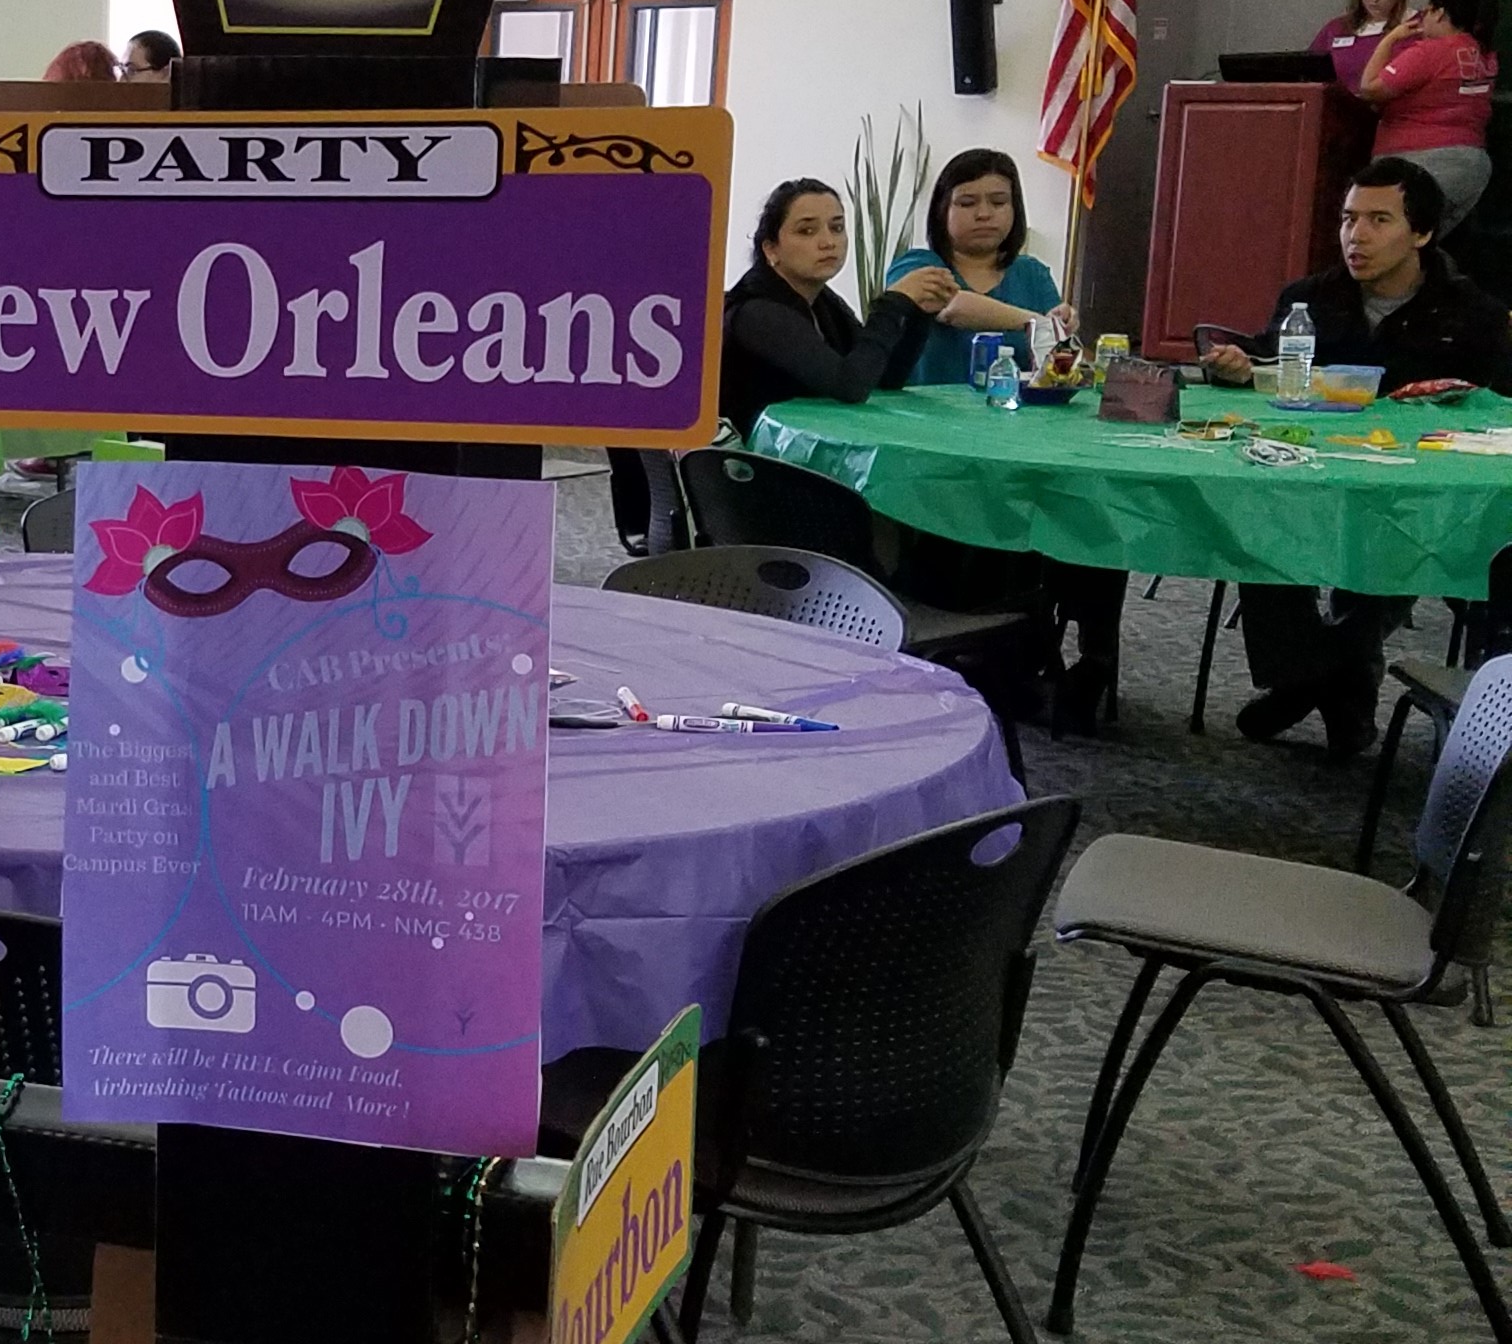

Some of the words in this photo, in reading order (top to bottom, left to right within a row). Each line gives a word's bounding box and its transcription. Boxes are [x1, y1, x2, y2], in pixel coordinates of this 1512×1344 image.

[80, 134, 453, 184] PARTY
[176, 240, 685, 389] Orleans
[267, 654, 344, 692] CAB
[73, 741, 115, 759] The
[119, 741, 194, 763] Biggest
[205, 721, 237, 790] A
[252, 702, 382, 783] WALK
[398, 682, 539, 767] DOWN
[89, 769, 128, 787] and
[135, 769, 181, 788] Best
[75, 797, 137, 815] Mardi
[143, 798, 193, 817] Gras
[320, 773, 413, 864] IVY
[89, 826, 148, 848] Party
[153, 830, 179, 845] on
[63, 853, 146, 875] Campus
[152, 855, 201, 874] Ever
[242, 866, 369, 905] February
[457, 889, 521, 915] 2017
[242, 903, 298, 924] 11AM
[321, 910, 372, 931] 4PM
[394, 915, 451, 938] NMC
[457, 922, 502, 943] 438
[89, 1044, 147, 1067] There
[151, 1047, 189, 1067] will
[192, 1047, 216, 1069] be
[221, 1051, 280, 1073] FREE
[283, 1057, 343, 1083] Cajun
[92, 1077, 208, 1101] Airbrushing
[213, 1079, 289, 1105] Tattoos
[293, 1090, 333, 1110] and
[346, 1094, 397, 1119] More
[584, 1149, 605, 1205] Rue
[605, 1084, 654, 1170] Bourbon
